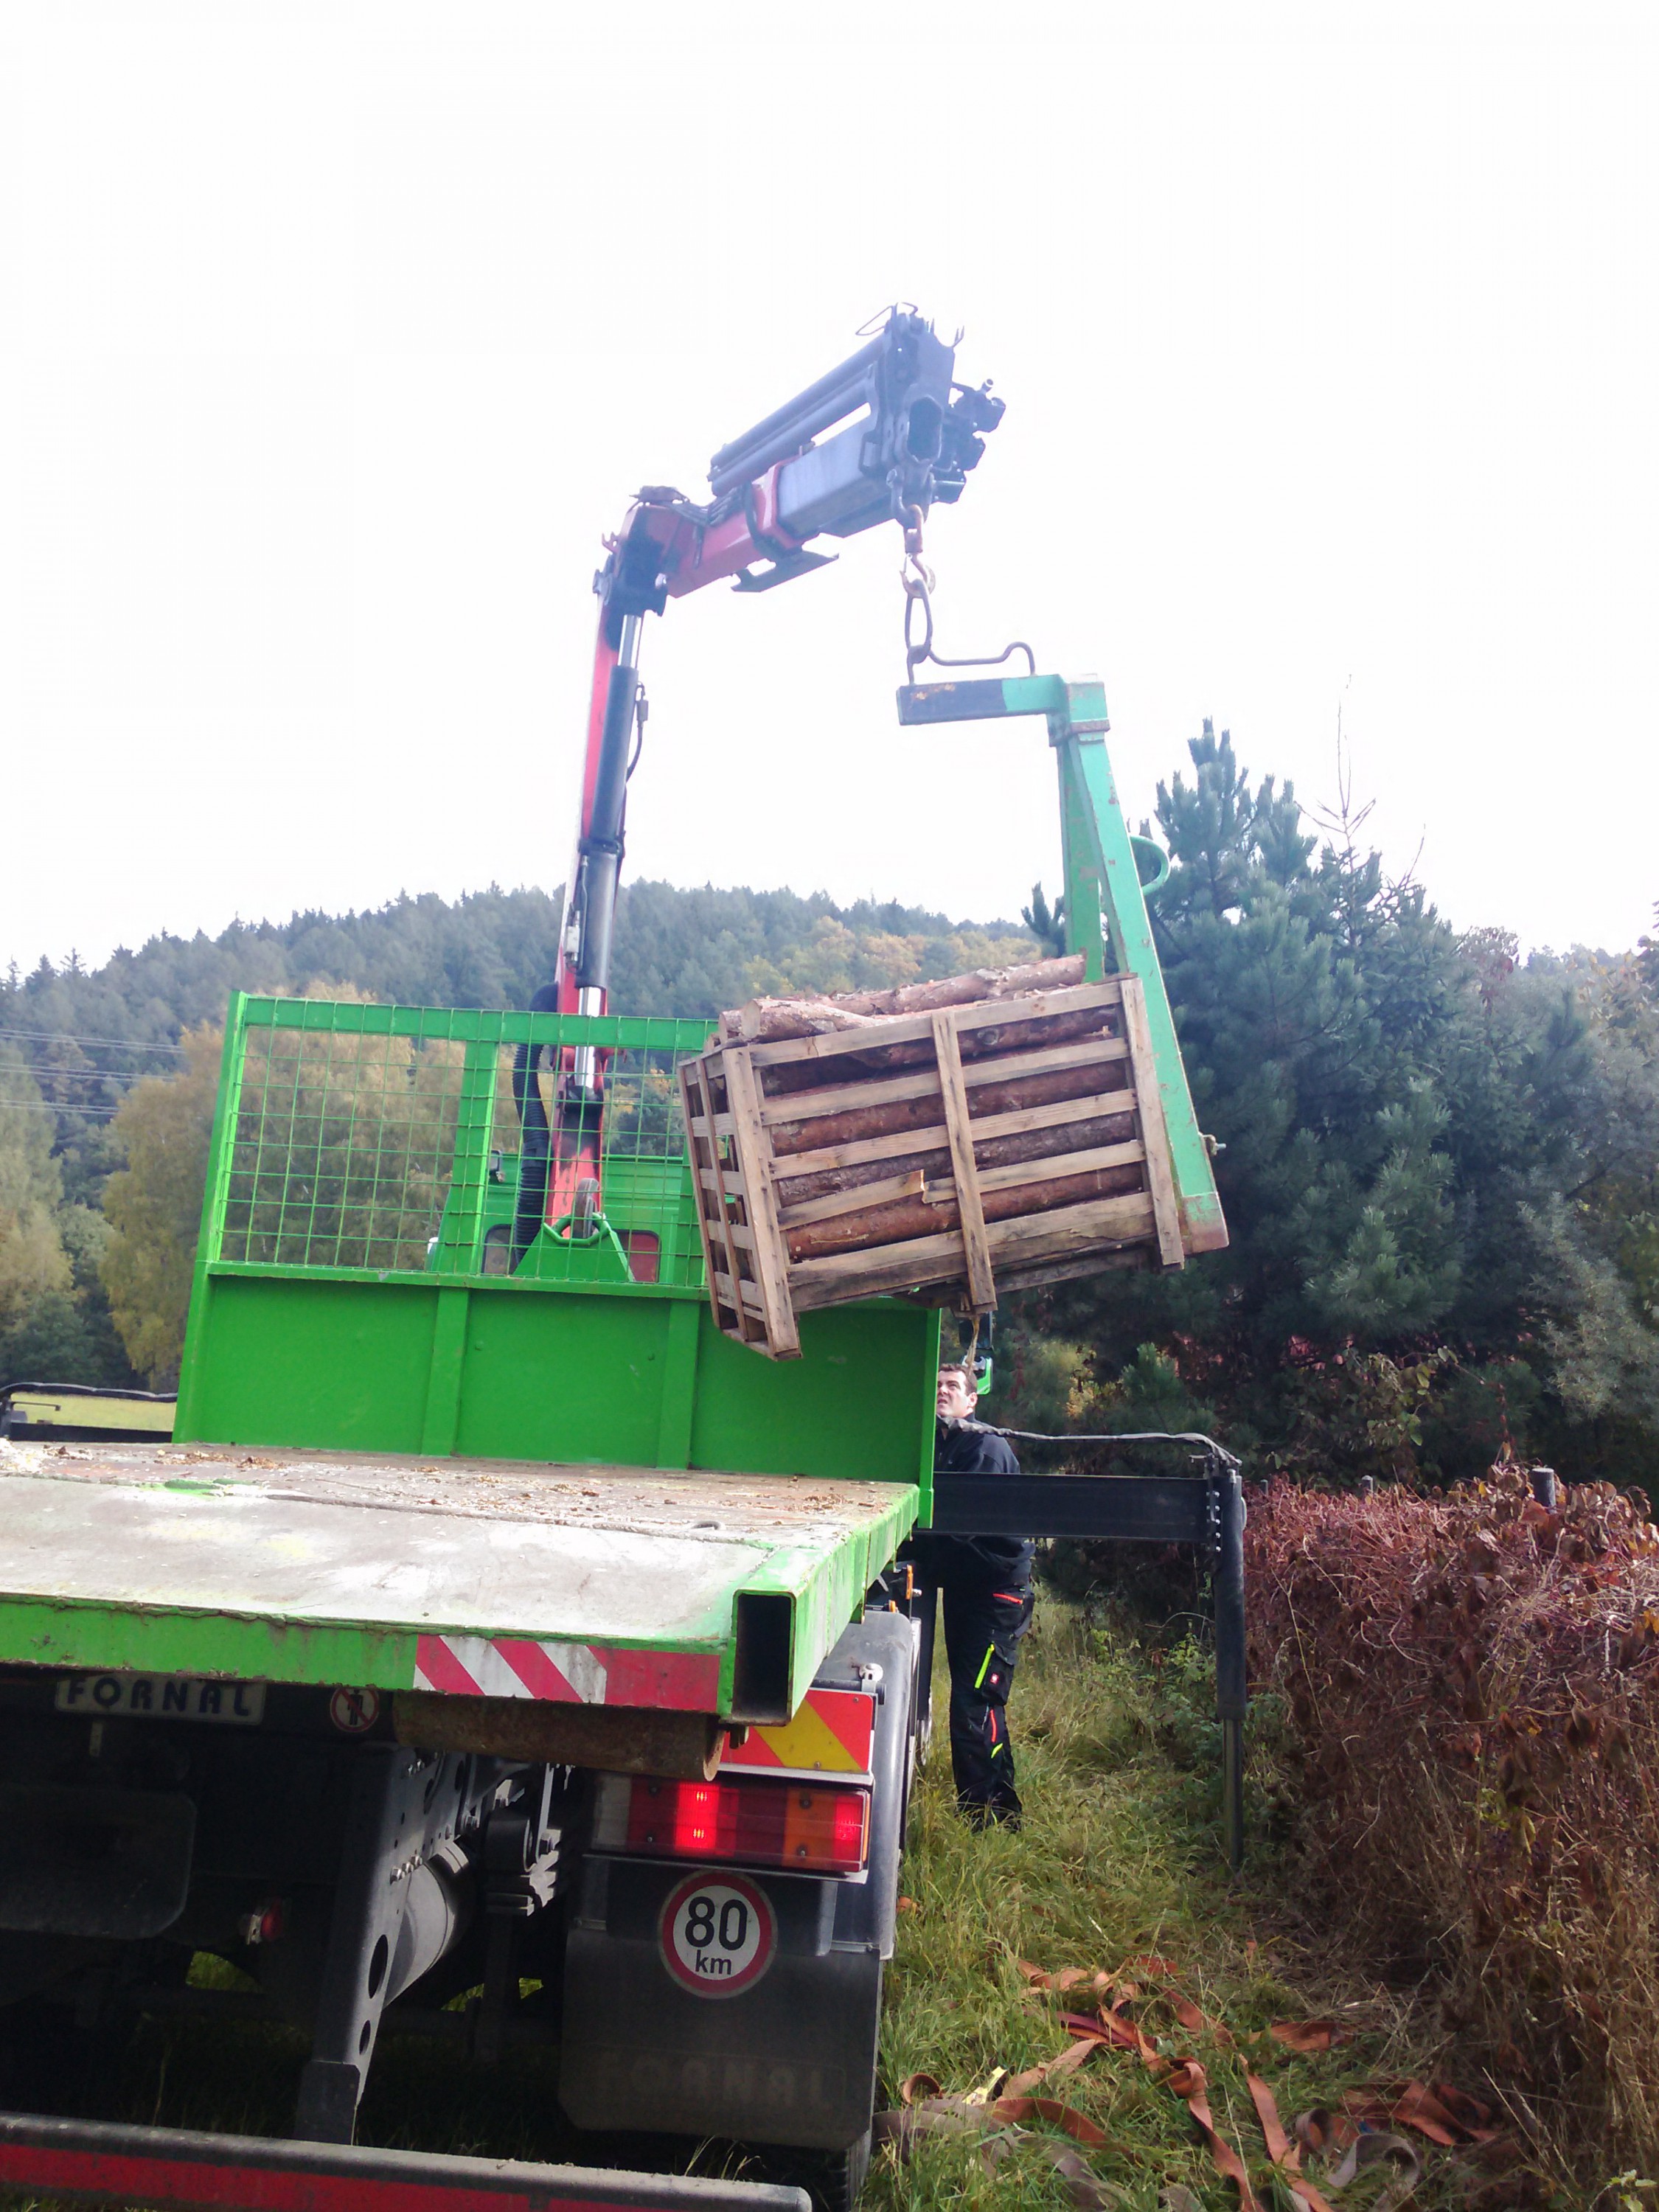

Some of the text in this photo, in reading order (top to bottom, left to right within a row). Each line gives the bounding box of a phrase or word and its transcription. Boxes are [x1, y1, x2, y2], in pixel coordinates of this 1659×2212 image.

[67, 1677, 249, 1717] FORNAL
[685, 1896, 748, 1951] 80
[695, 1949, 732, 1975] km
